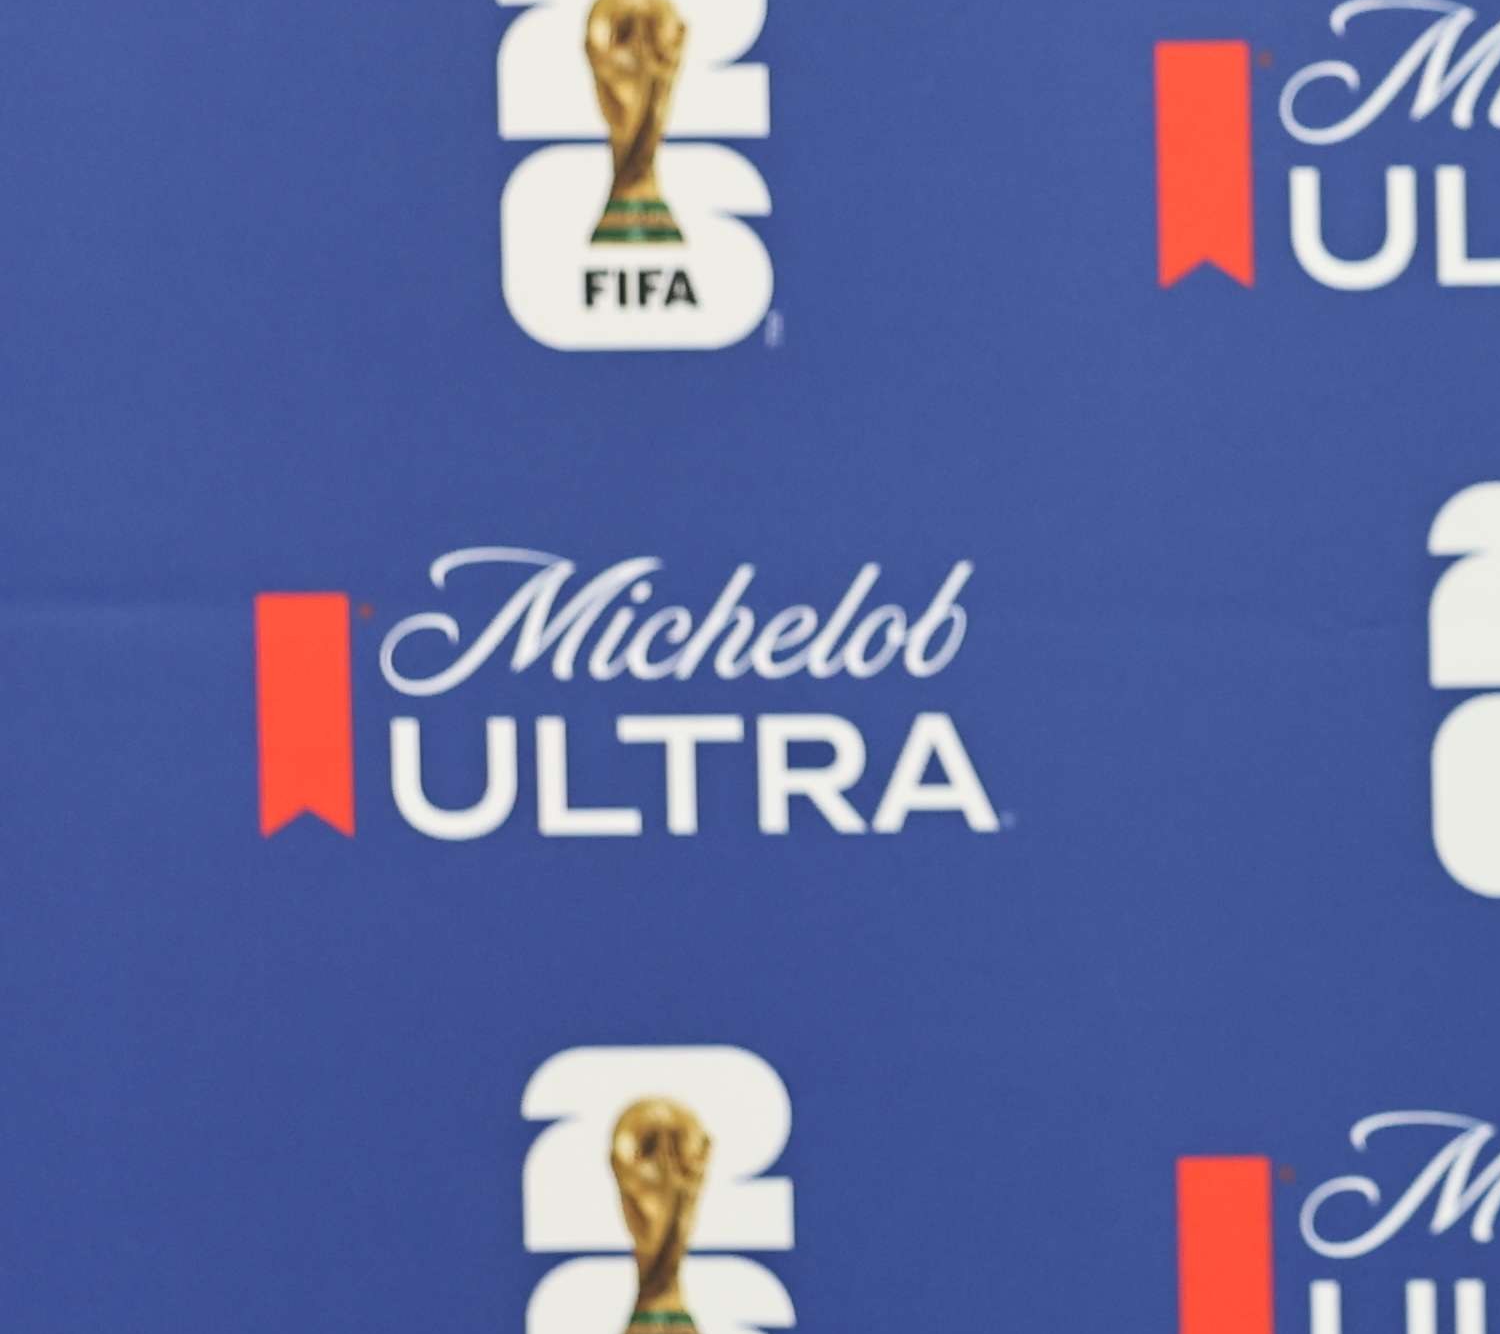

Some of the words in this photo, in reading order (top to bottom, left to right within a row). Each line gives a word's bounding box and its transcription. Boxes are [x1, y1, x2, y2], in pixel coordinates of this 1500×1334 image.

[585, 270, 697, 307] FIFA
[380, 547, 972, 696] Michelob
[391, 713, 998, 840] ULTRA
